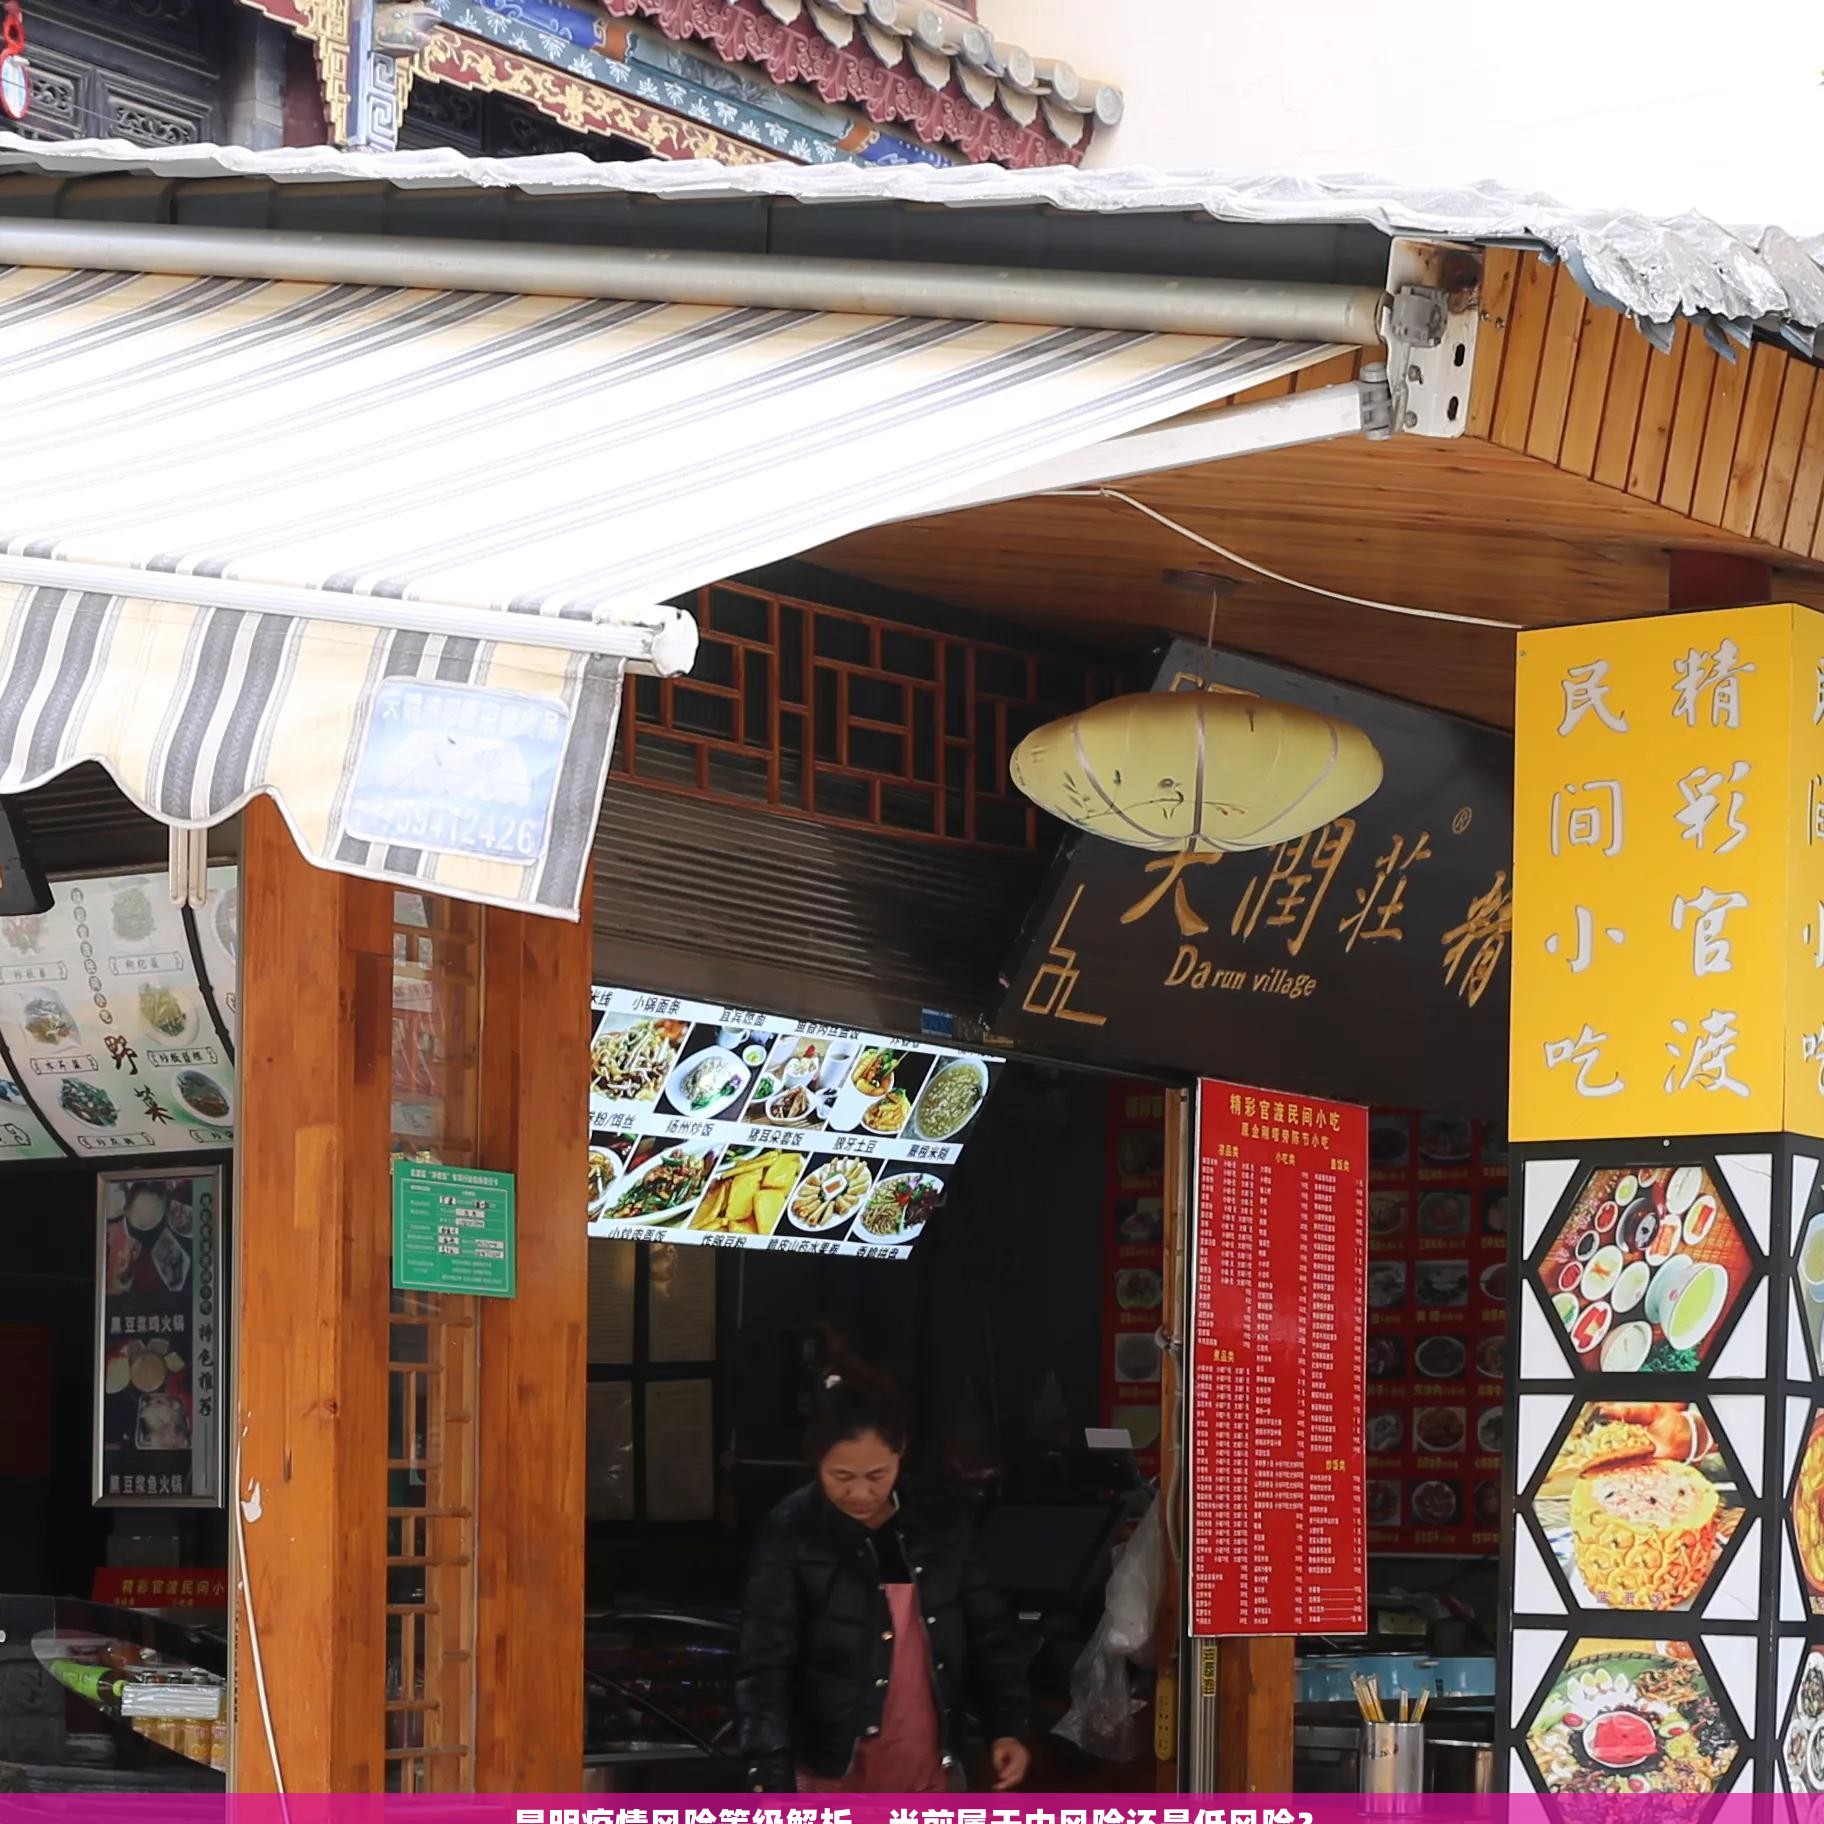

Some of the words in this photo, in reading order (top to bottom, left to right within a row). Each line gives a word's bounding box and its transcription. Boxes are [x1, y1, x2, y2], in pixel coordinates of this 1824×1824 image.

[1543, 658, 1629, 1098] 民间小吃
[1664, 638, 1756, 1099] 精彩官渡
[1252, 967, 1317, 999] village
[632, 994, 682, 1015] 小锅面条
[666, 1120, 714, 1138] 扬州炒饭
[1230, 1093, 1341, 1132] 精彩官渡民间小吃
